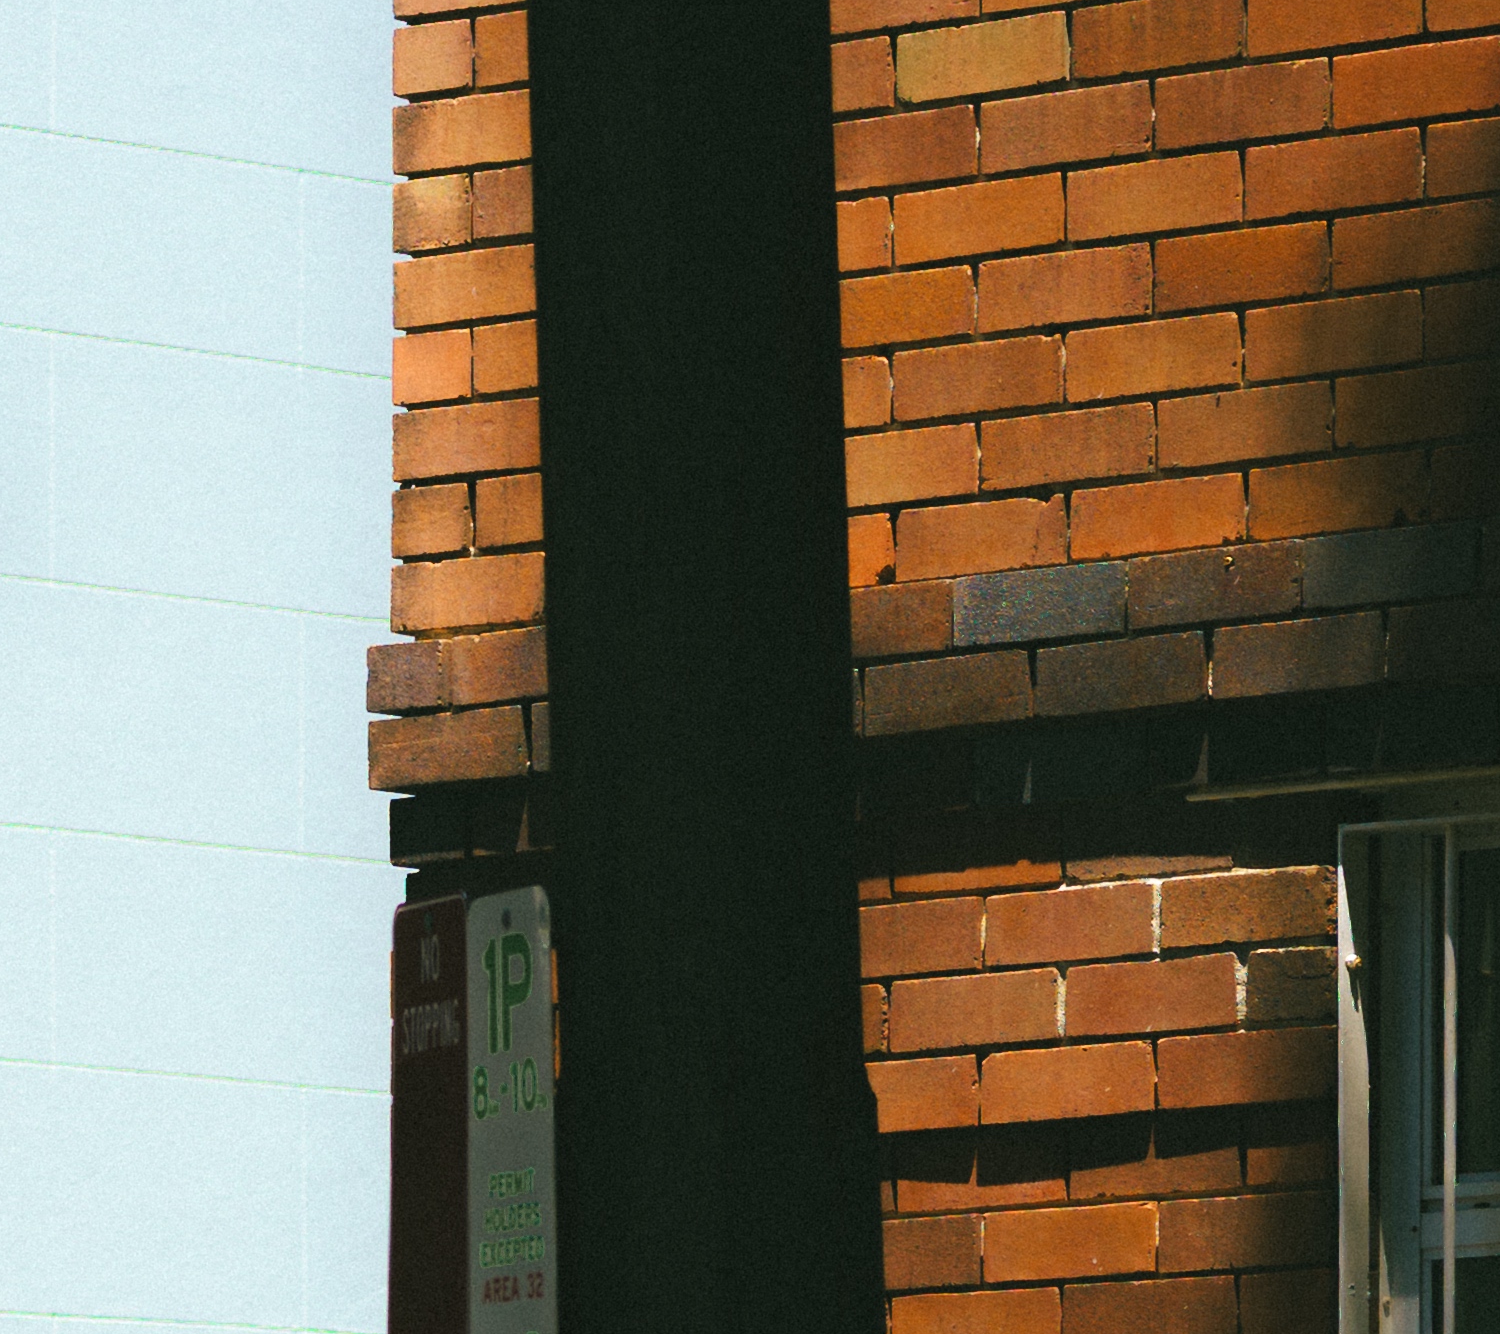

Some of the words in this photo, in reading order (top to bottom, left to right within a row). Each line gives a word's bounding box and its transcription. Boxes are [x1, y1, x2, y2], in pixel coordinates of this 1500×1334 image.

[420, 934, 440, 983] NO
[484, 932, 533, 1054] 1P
[402, 998, 461, 1055] STOPPING
[488, 1167, 535, 1199] PERMIT
[483, 1201, 541, 1233] HOLDERS
[480, 1235, 545, 1268] EXCEPTED
[482, 1275, 521, 1304] AREA
[527, 1271, 544, 1299] 32
